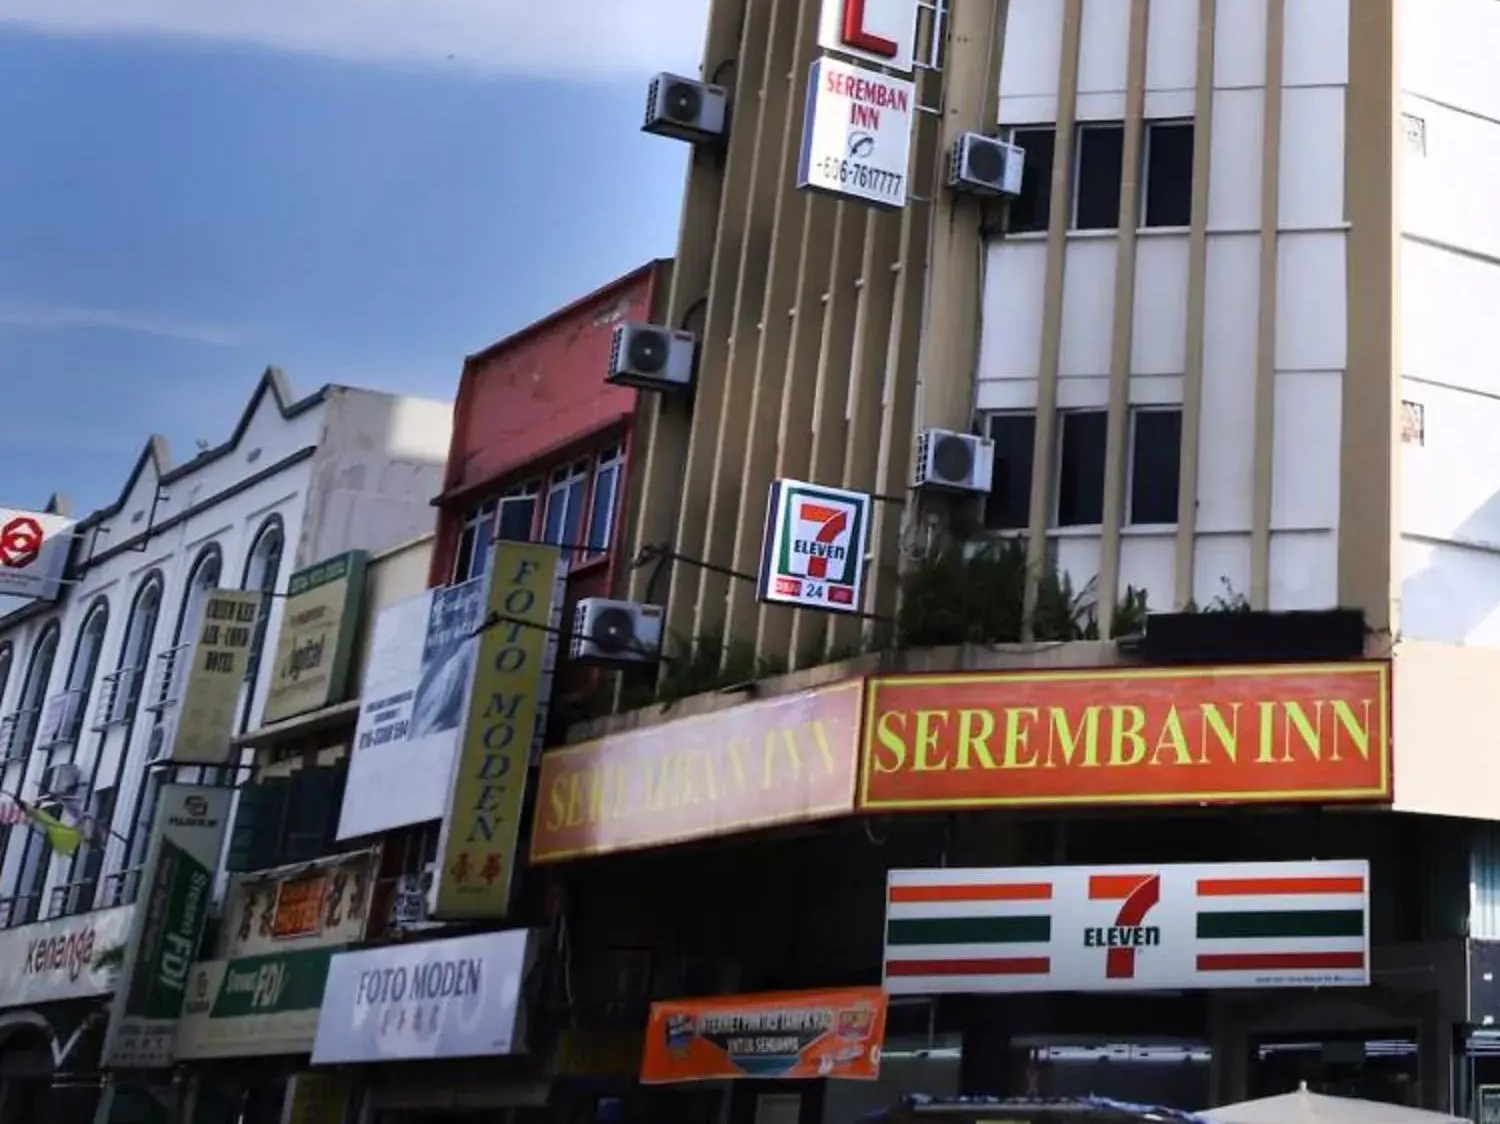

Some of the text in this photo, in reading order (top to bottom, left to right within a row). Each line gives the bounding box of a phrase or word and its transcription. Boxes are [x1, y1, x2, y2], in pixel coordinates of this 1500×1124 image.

[826, 71, 908, 113] SEREMBAN
[850, 103, 880, 131] INN
[800, 504, 848, 578] 7
[495, 559, 540, 673] FOTO
[806, 583, 824, 598] 24
[465, 692, 528, 842] MODEN
[873, 699, 1374, 774] SEREMBAN INN
[1088, 875, 1161, 978] 7
[356, 958, 483, 1005] FOTO MODEN
